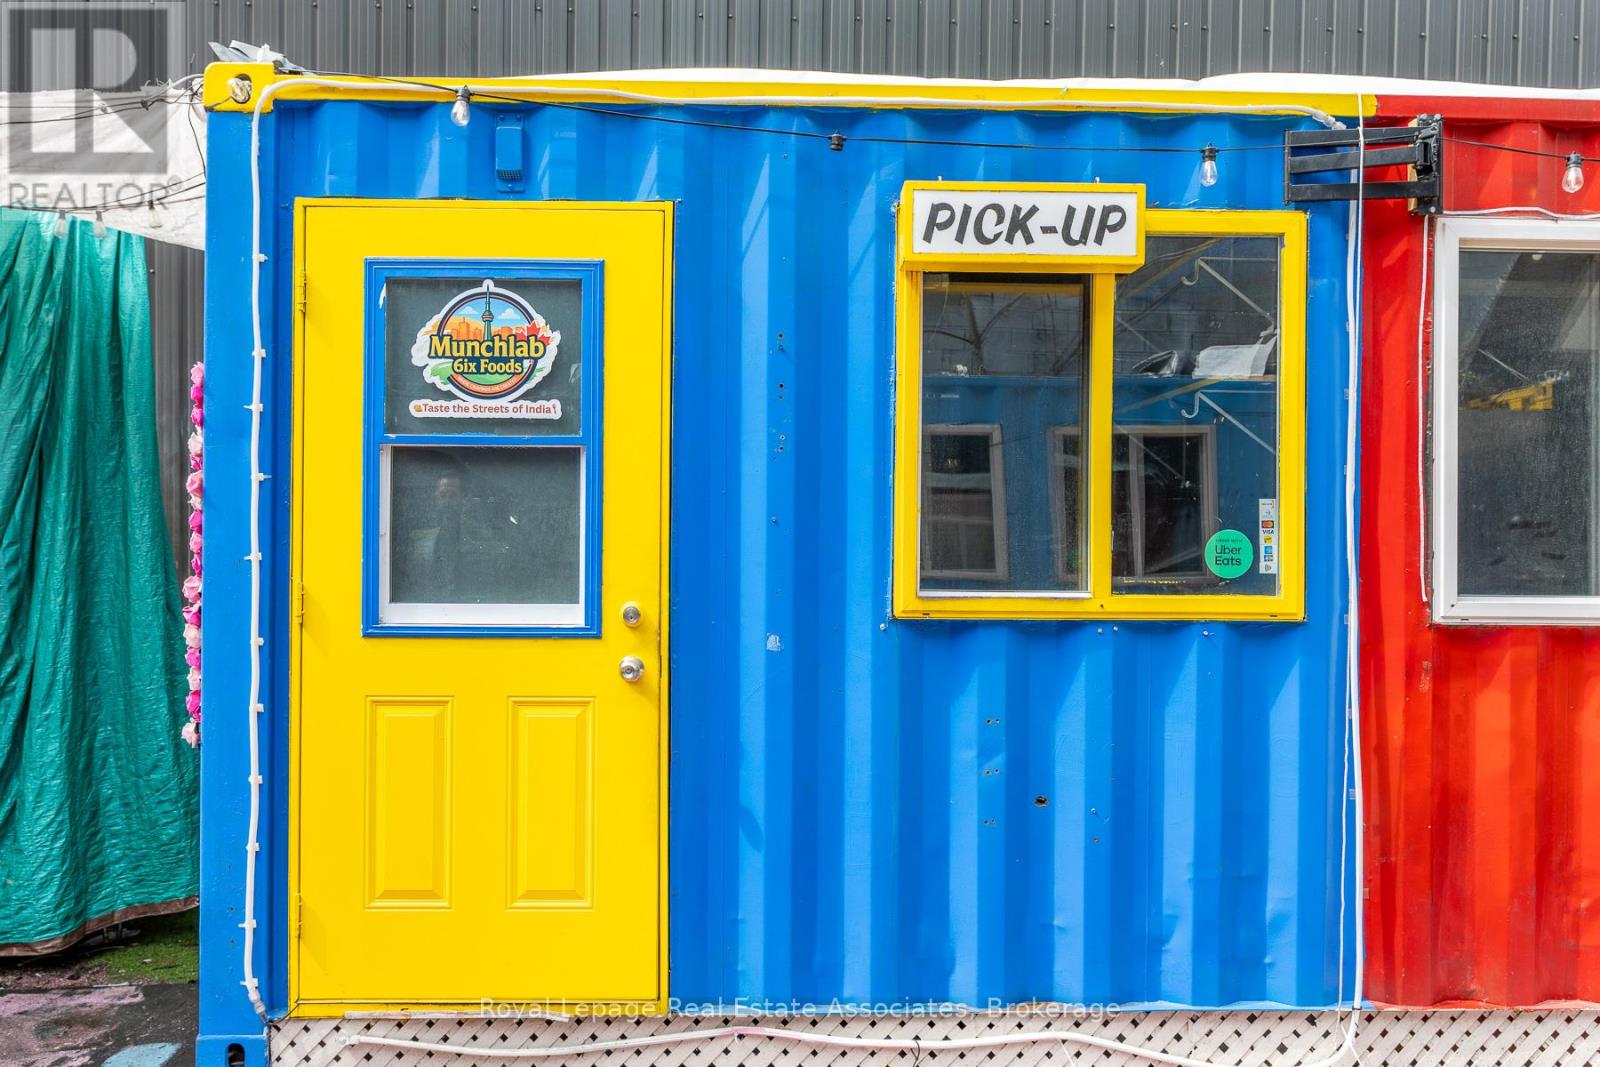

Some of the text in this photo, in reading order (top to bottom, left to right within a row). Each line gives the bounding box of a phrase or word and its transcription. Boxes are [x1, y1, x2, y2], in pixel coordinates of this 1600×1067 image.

[922, 202, 1127, 247] PICK-UP
[428, 335, 545, 358] Munchlab
[453, 359, 522, 373] 6ix Foods
[422, 403, 551, 414] Taste the Streets of India
[1216, 545, 1242, 554] Uber
[1216, 556, 1242, 566] Eats
